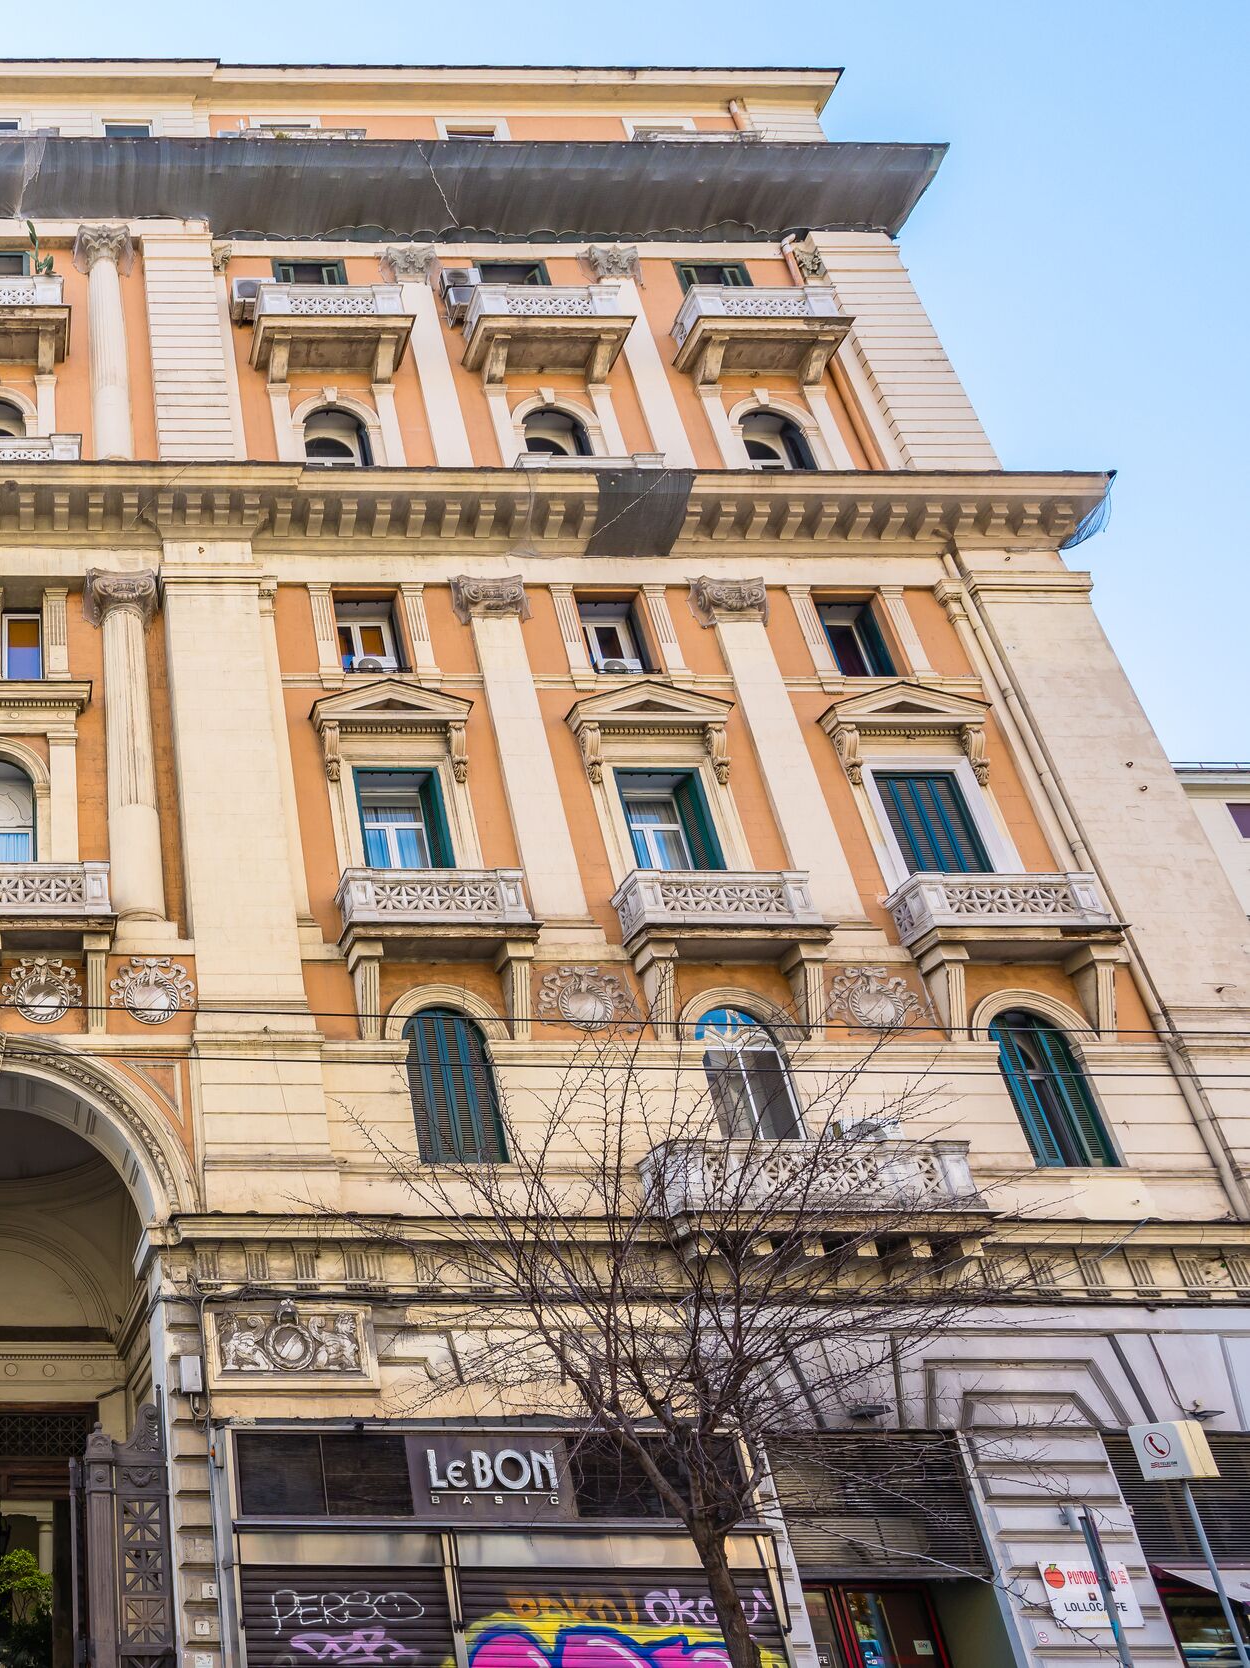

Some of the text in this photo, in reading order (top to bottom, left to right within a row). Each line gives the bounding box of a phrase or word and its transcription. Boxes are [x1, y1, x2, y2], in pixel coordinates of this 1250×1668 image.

[431, 1496, 560, 1505] BASIC
[208, 1586, 214, 1596] 5
[1063, 1602, 1129, 1612] LOLLOCFE
